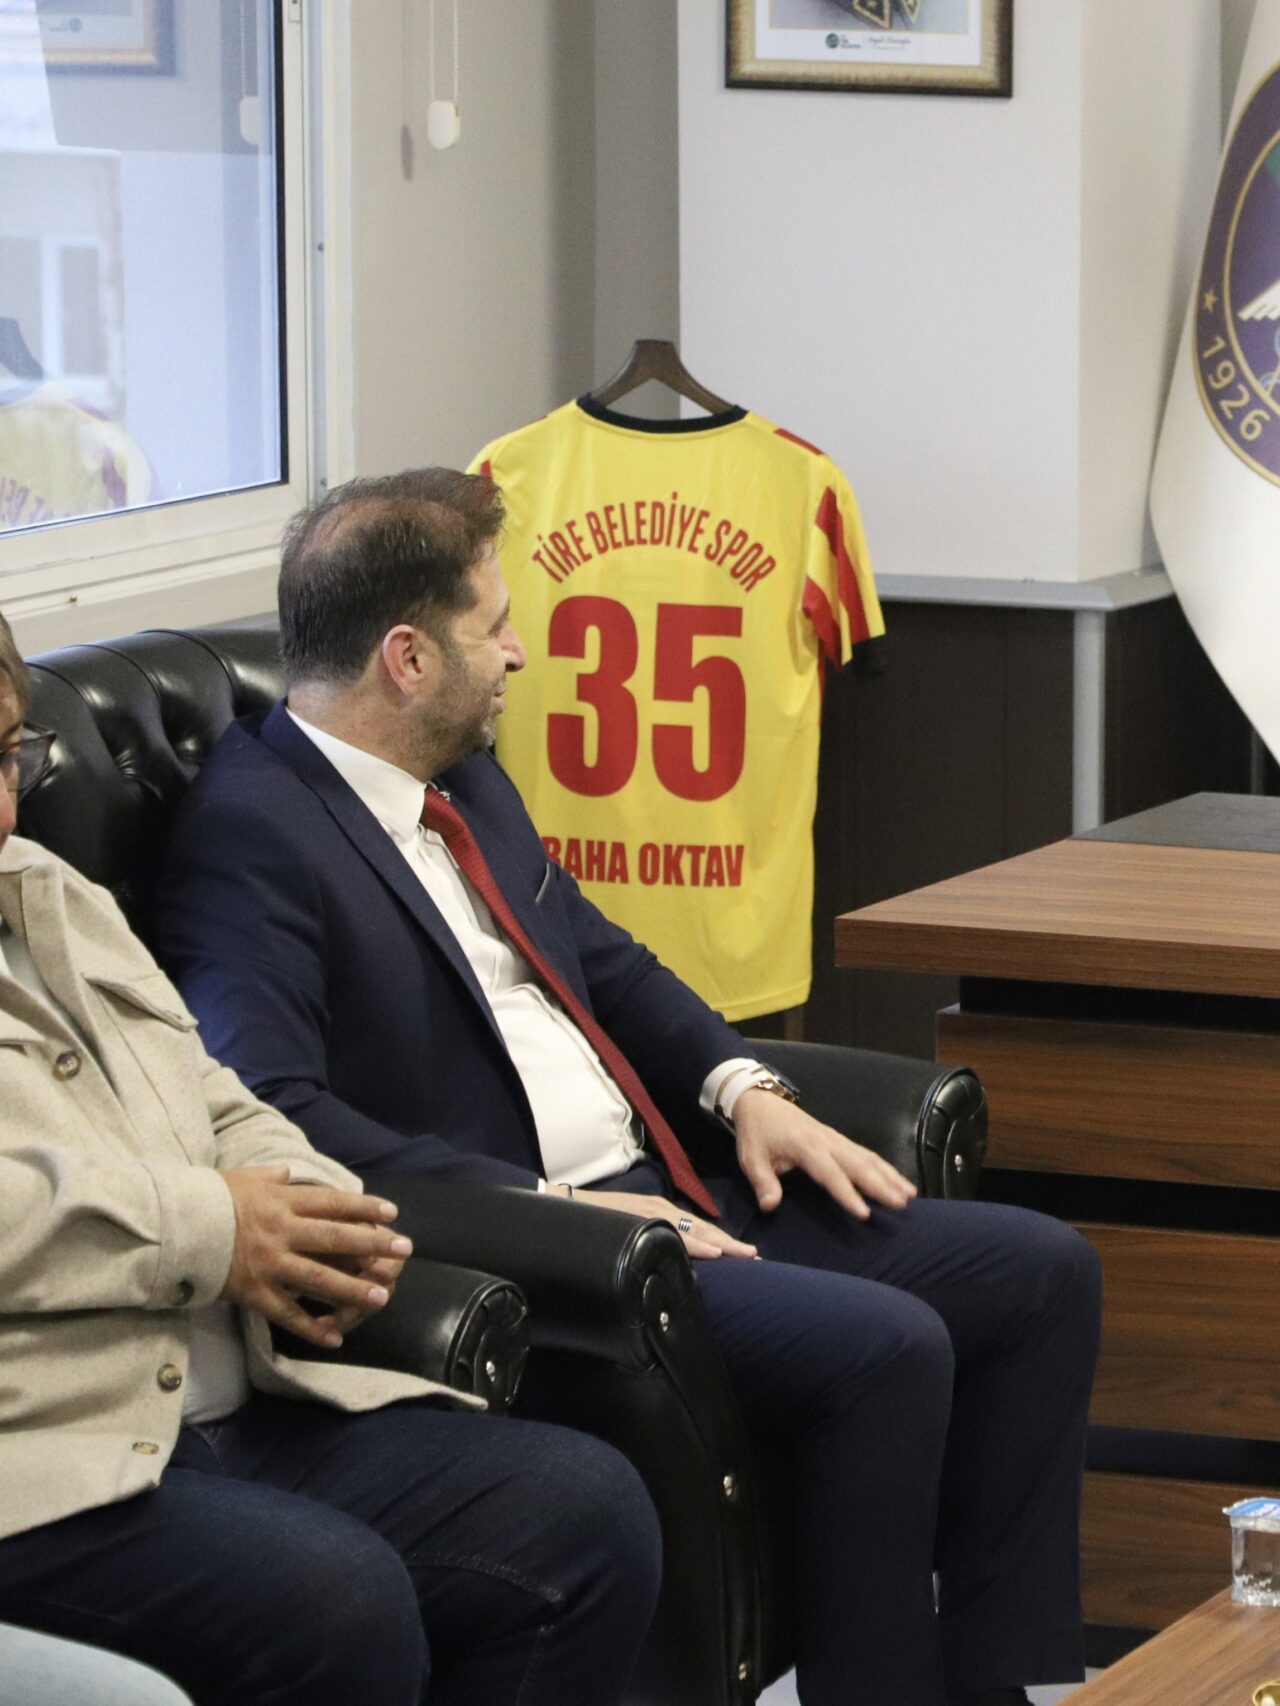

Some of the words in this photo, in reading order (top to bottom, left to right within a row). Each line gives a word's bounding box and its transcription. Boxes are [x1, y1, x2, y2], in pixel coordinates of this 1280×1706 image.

[1203, 336, 1271, 442] 1926
[532, 514, 593, 584] TİRE
[704, 519, 777, 593] SPOR
[547, 595, 746, 802] 35
[638, 842, 745, 887] OKTAV
